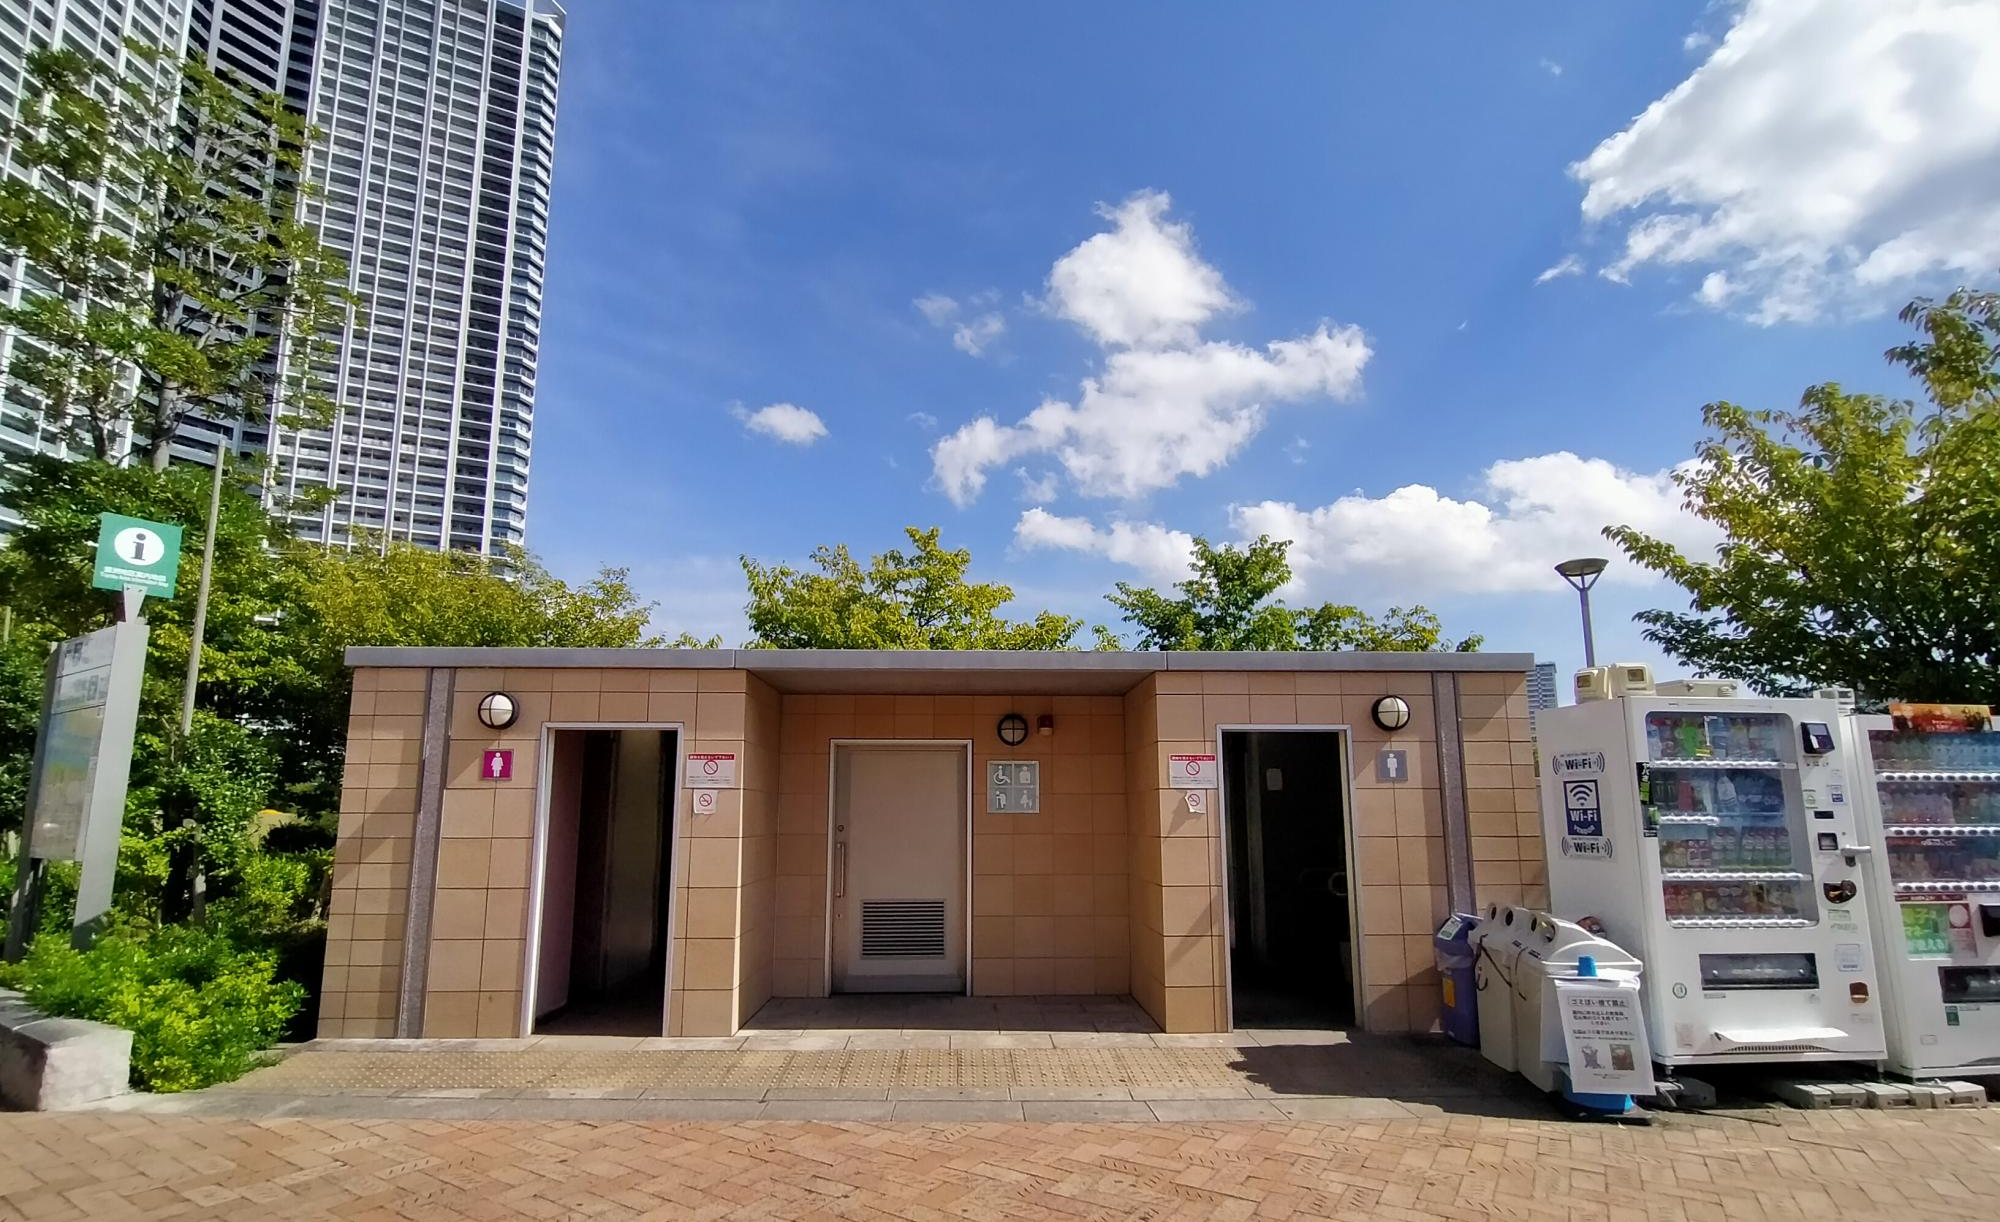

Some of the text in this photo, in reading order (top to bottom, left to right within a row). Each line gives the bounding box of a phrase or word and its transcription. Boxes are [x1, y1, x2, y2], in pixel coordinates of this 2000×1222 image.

[1565, 758, 1592, 770] Wi-Fi
[1570, 810, 1597, 822] Wi-Fi
[1573, 842, 1600, 854] Wi-Fi
